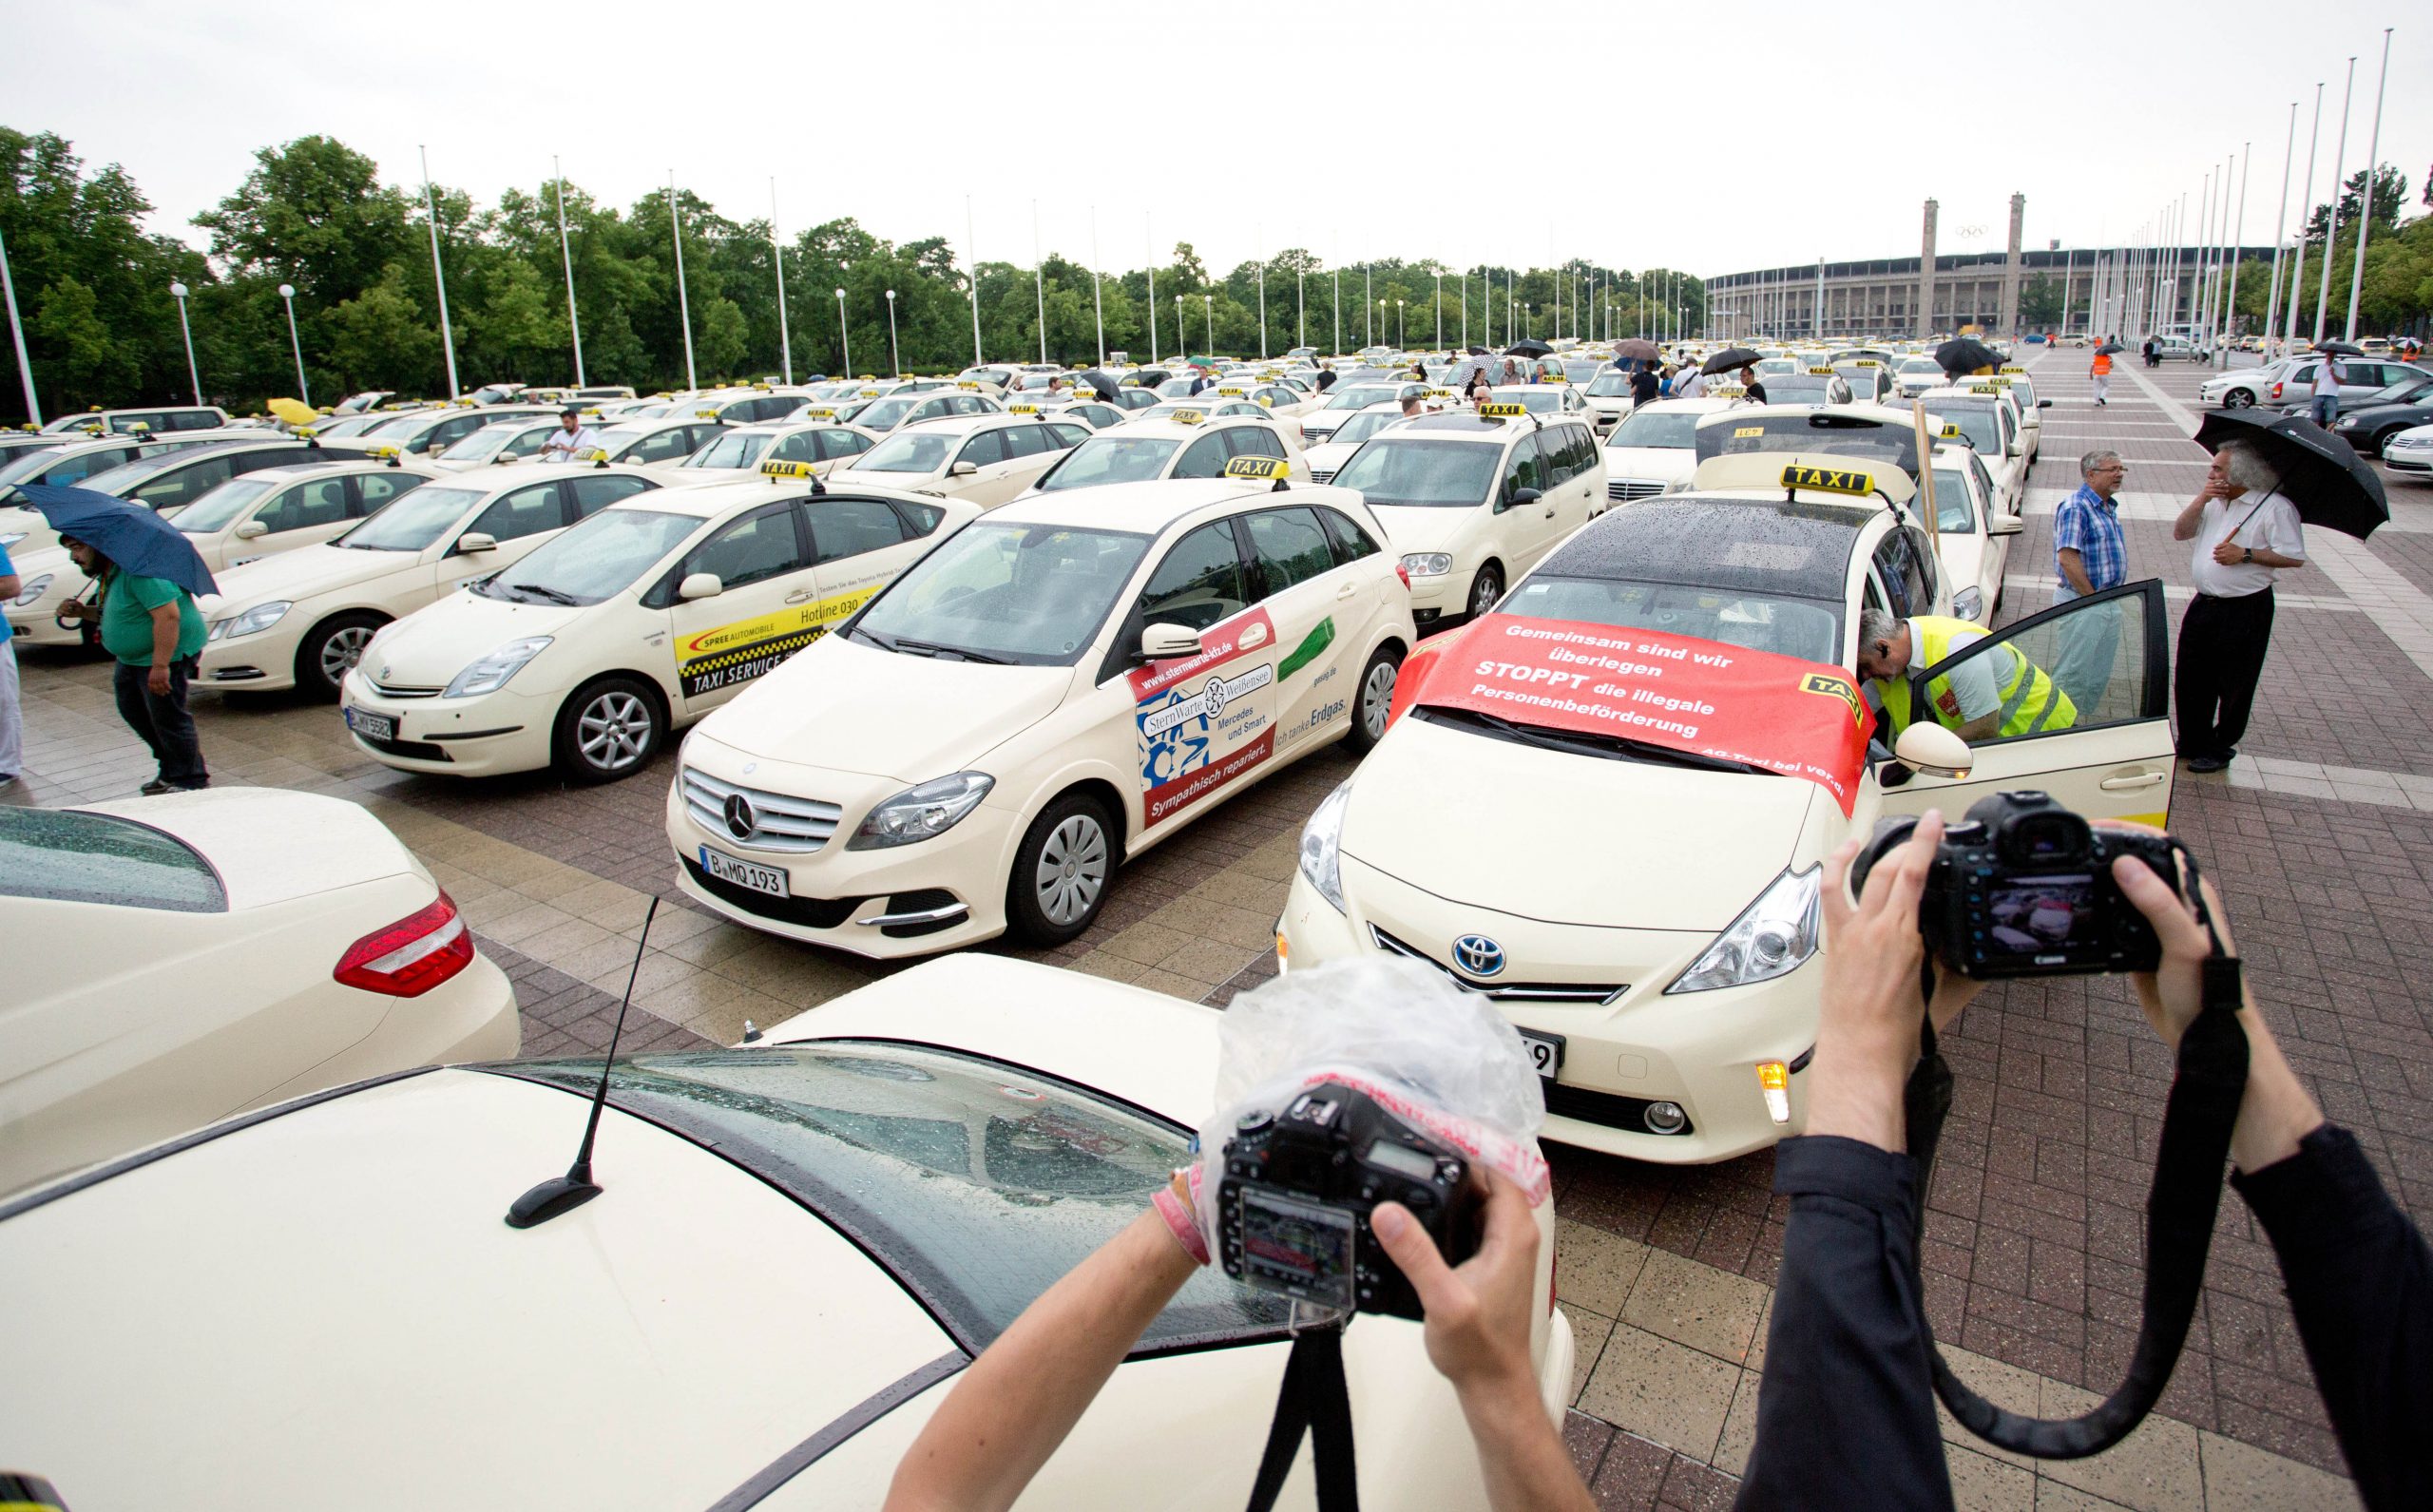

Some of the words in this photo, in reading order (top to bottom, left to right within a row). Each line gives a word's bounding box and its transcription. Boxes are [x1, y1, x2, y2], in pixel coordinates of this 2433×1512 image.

[1176, 411, 1195, 420] TAXI
[1485, 405, 1514, 414] TAXI
[765, 463, 793, 474] TAXI
[1235, 460, 1272, 475] TAXI
[1794, 468, 1855, 488] TAXI
[819, 584, 837, 594] Testen
[858, 575, 875, 585] Toyota
[801, 604, 837, 624] Hotline
[840, 599, 858, 614] 030
[704, 634, 729, 648] SPREE
[730, 623, 775, 641] AUTOMOBILE
[1505, 624, 1631, 650] Gemeinsam
[1637, 642, 1688, 660] sind
[1694, 653, 1734, 669] wir
[694, 671, 724, 693] TAXI
[727, 656, 781, 683] SERVICE
[1141, 642, 1233, 691] www.sternwarte-kfz.de
[1313, 666, 1337, 687] gasag.de
[1548, 646, 1662, 677] überlegen
[1150, 699, 1203, 732] SternWarte
[1226, 672, 1269, 697] Weißensee
[1475, 660, 1590, 690] STOPPT
[1593, 682, 1626, 699] die
[1632, 689, 1715, 715] illegale
[1816, 679, 1862, 719] TAXI
[1217, 706, 1254, 731] Mercedes
[1275, 731, 1288, 747] Ich
[1289, 720, 1311, 738] tanke
[1311, 699, 1346, 728] Erdgas.
[1471, 683, 1699, 739] Personenbeförderung
[1228, 726, 1241, 741] und
[1243, 715, 1267, 735] Smart
[1151, 770, 1220, 817] Sympathisch
[1223, 743, 1266, 776] repariert.
[1701, 748, 1770, 766] AG-Taxi
[1772, 760, 1802, 772] bei
[1806, 764, 1845, 797] ver.di
[711, 855, 721, 873] B
[728, 861, 748, 884] MQ
[750, 869, 779, 892] 193
[1523, 1040, 1551, 1070] 9
